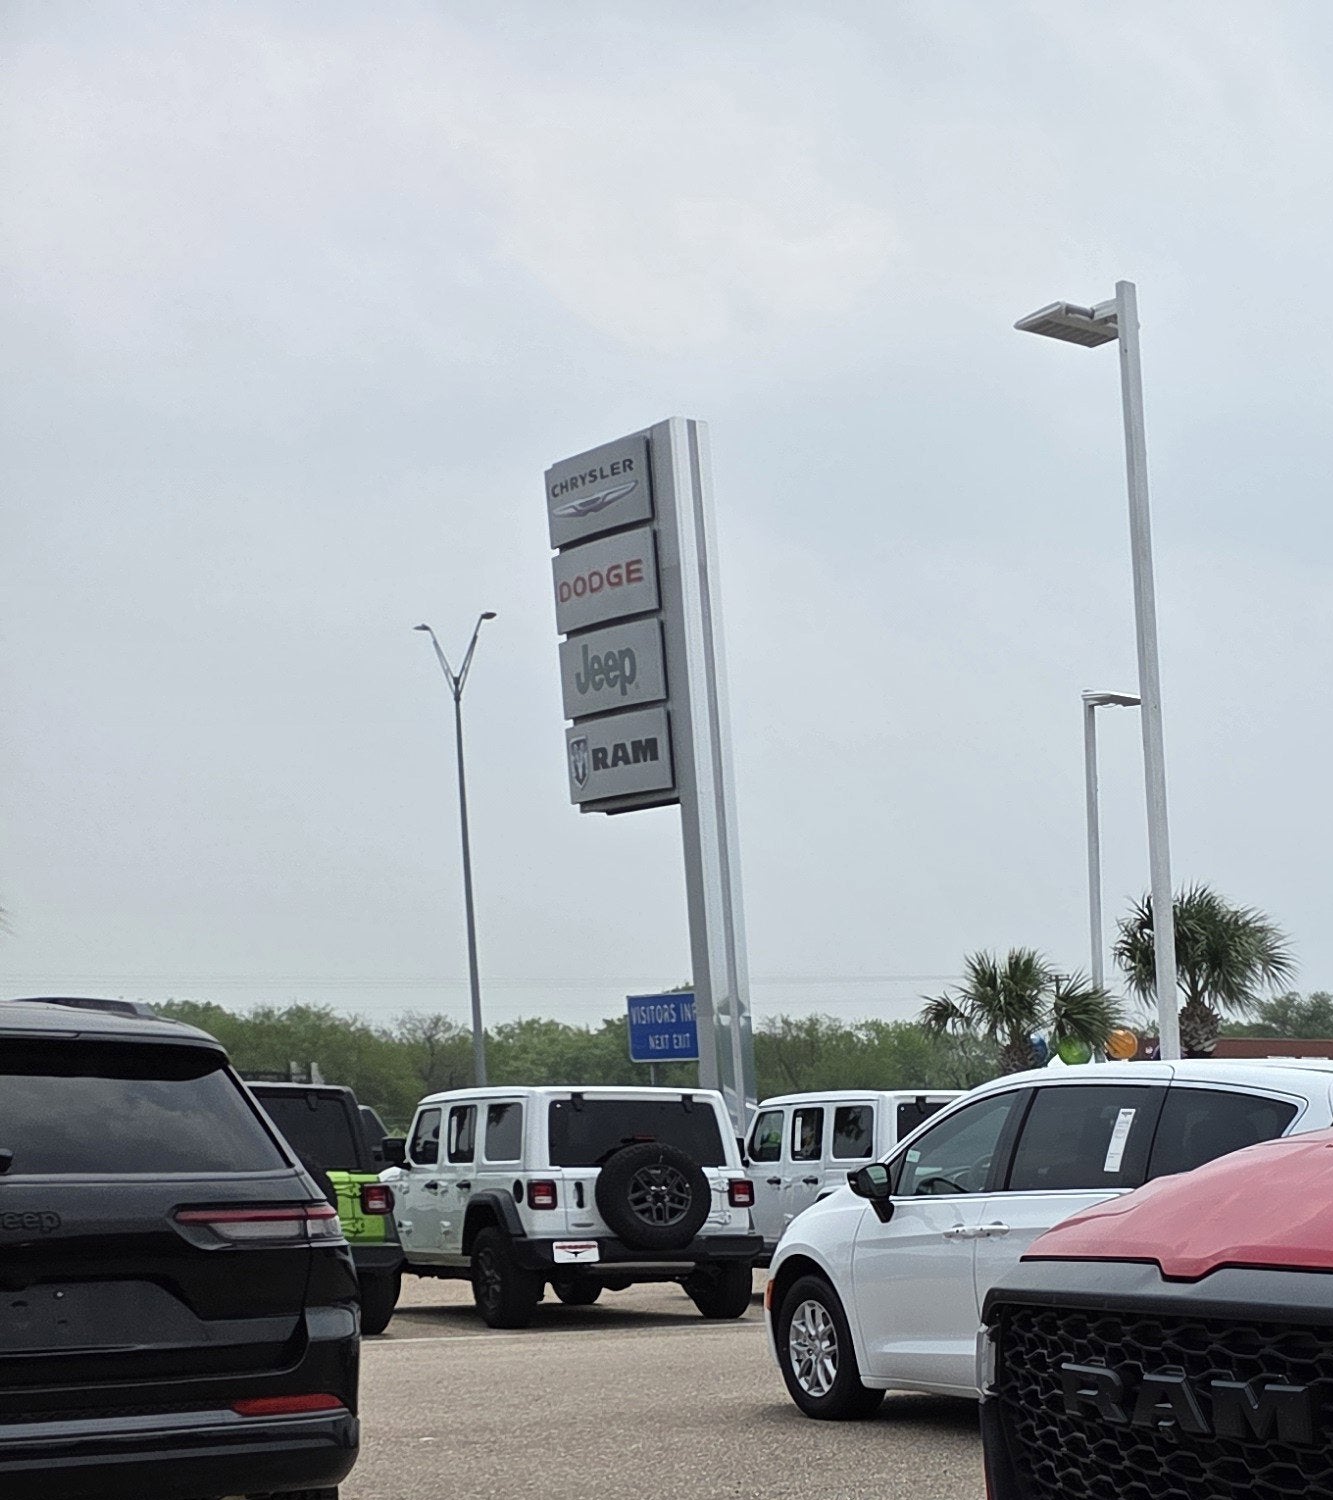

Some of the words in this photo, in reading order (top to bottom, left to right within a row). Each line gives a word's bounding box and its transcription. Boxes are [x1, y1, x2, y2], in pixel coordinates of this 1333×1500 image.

[551, 458, 634, 498] CHRYSLER
[559, 558, 644, 603] DODGE
[575, 643, 637, 697] Jeep
[591, 737, 659, 772] RAM
[631, 1003, 677, 1025] VISITORS
[648, 1033, 670, 1050] NEXT
[672, 1032, 691, 1049] EXIT
[0, 1211, 61, 1235] eep
[1060, 1361, 1313, 1445] RAM
